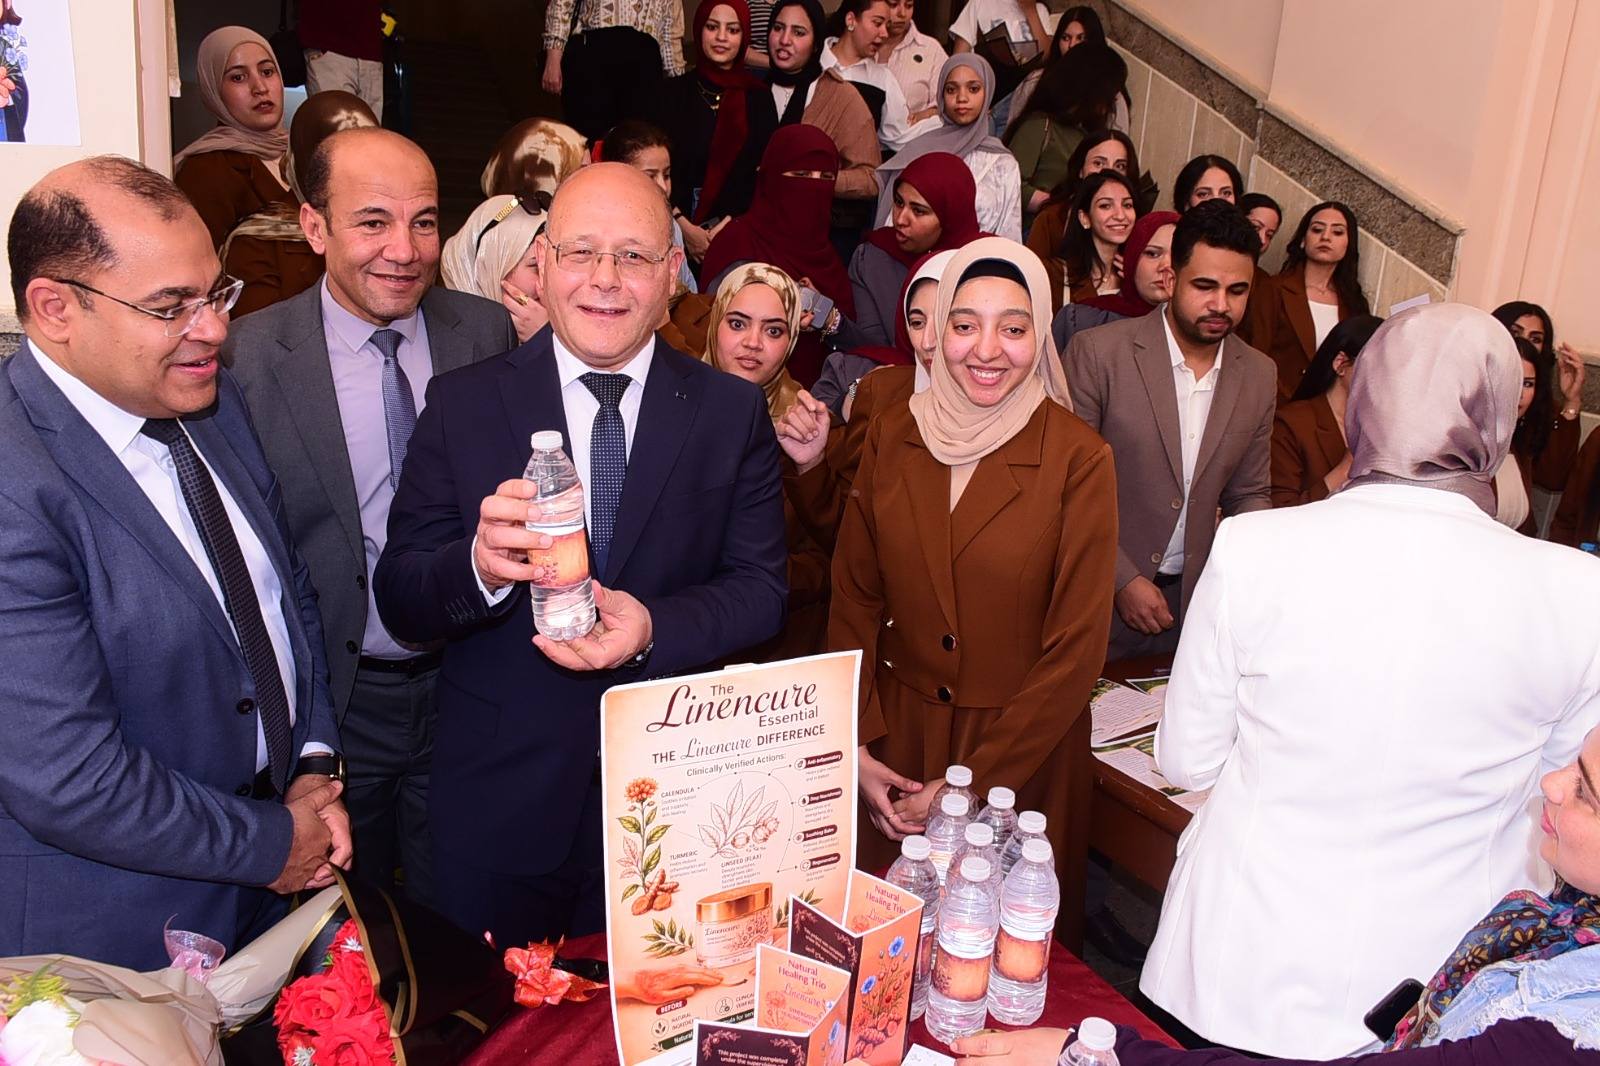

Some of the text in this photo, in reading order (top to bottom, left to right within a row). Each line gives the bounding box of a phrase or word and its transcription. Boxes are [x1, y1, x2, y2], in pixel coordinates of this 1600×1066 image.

[710, 684, 734, 697] The
[646, 683, 818, 733] Linencure
[758, 705, 819, 728] Essential
[652, 724, 826, 765] THE Linencure DIFFERENCE
[686, 764, 723, 777] Clinically
[724, 757, 755, 770] Verified
[660, 787, 695, 798] CALENDULA
[669, 850, 698, 861] TURMERIC
[720, 858, 744, 868] LINSEED
[865, 890, 892, 911] Healing
[874, 884, 900, 902] Natural
[788, 959, 818, 976] Natural
[778, 966, 827, 990] Healing Trio
[784, 982, 821, 1008] Linencure
[660, 1000, 684, 1014] BEFORE
[673, 1031, 694, 1044] Natural
[729, 1051, 748, 1059] project
[760, 1055, 789, 1064] completed
